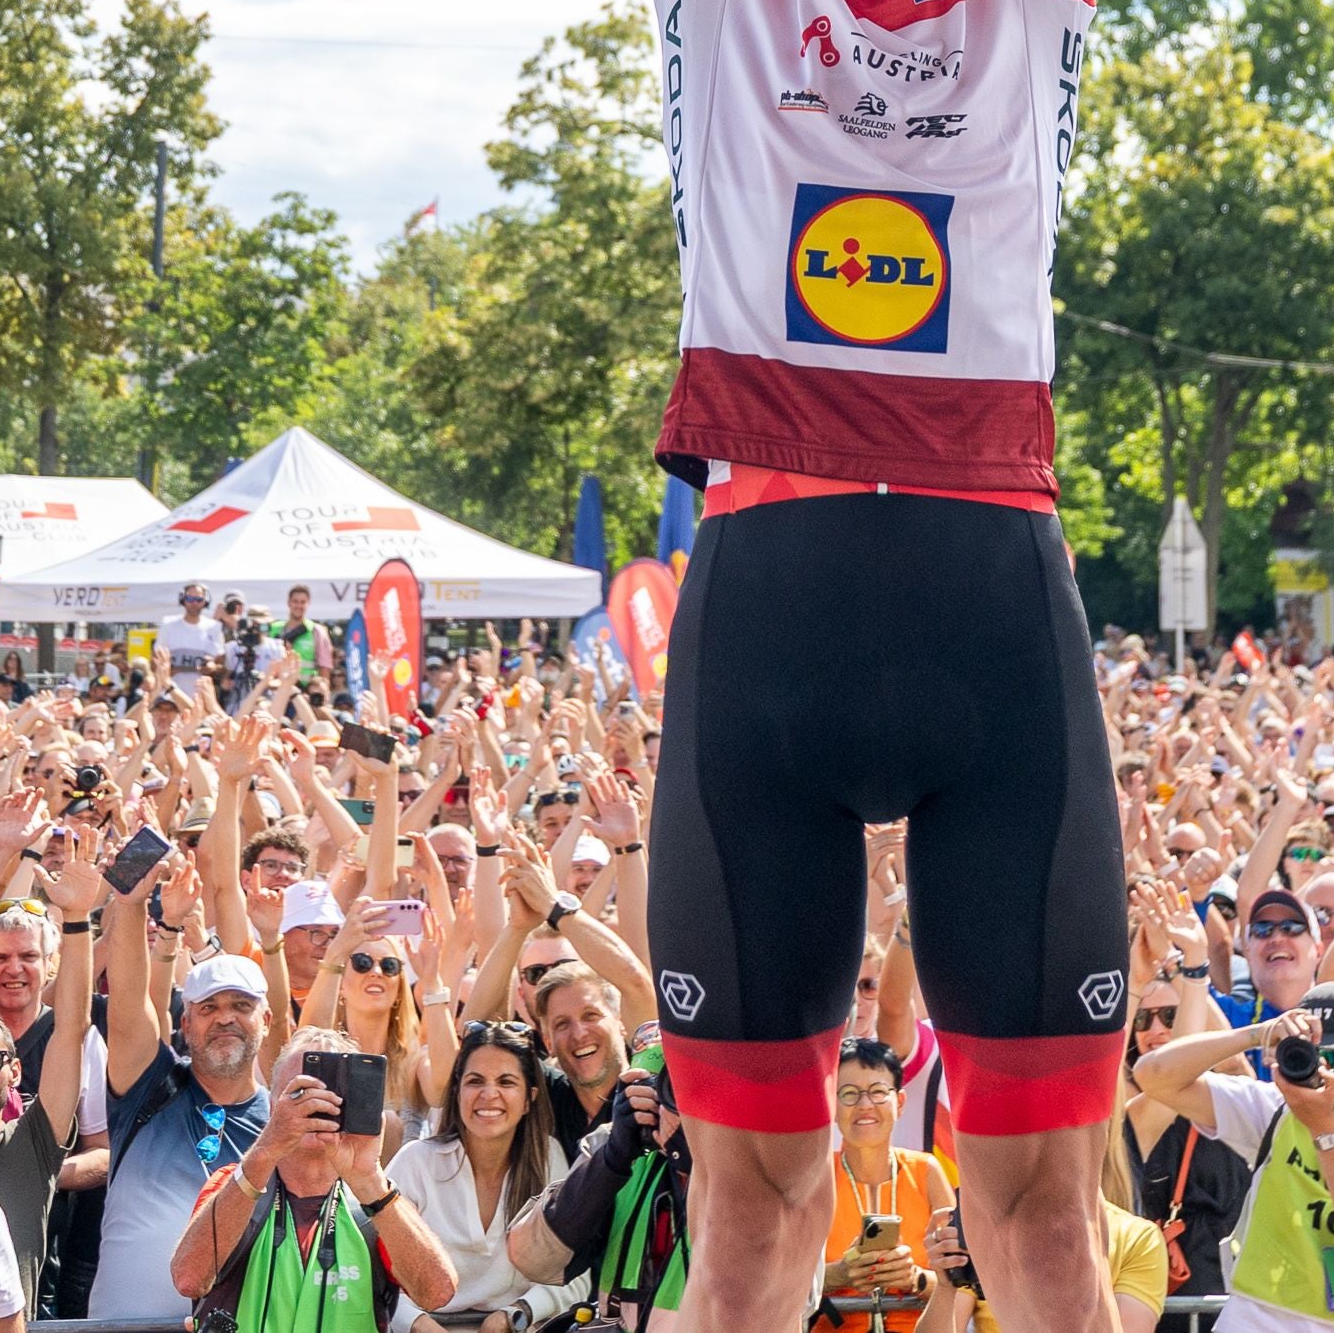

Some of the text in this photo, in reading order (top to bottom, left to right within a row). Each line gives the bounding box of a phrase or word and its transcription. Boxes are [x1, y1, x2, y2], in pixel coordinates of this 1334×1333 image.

[853, 45, 961, 82] AUSTRIA
[838, 114, 896, 131] SAALFELDEN
[843, 125, 888, 140] LEOGANG
[270, 504, 358, 523] TOUR
[278, 523, 323, 537] OF
[291, 535, 430, 552] AUSTRIA
